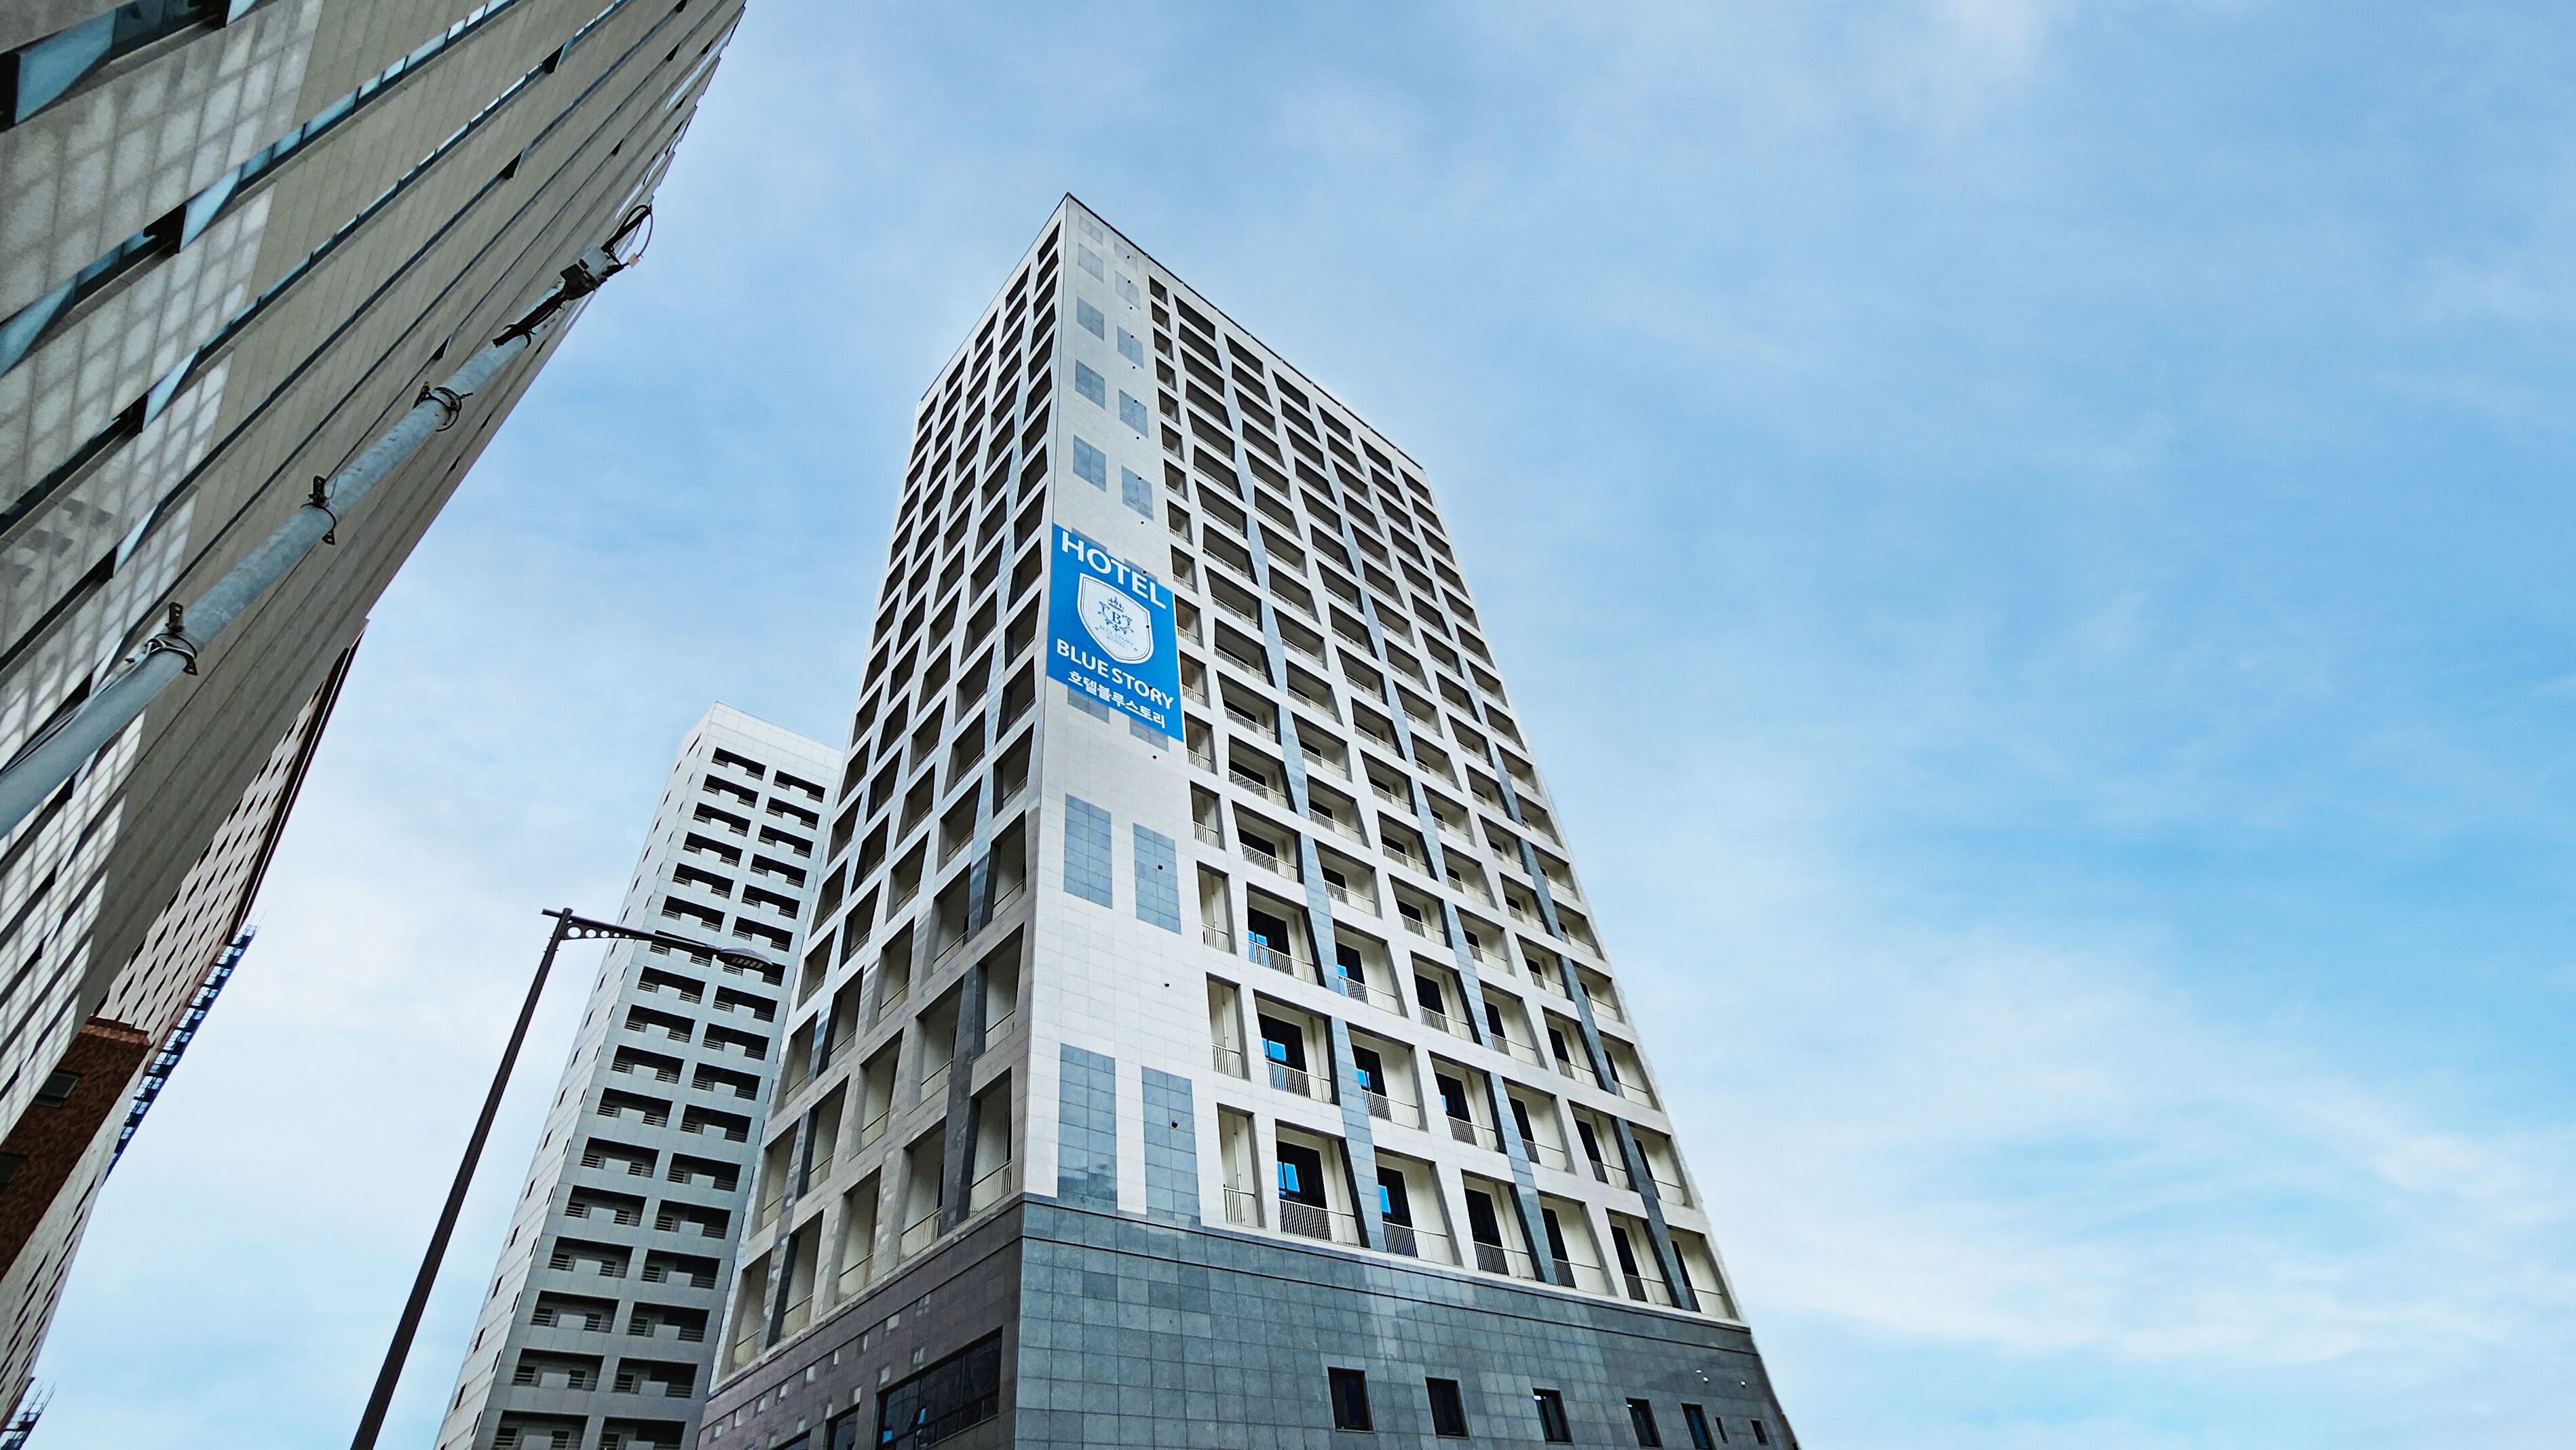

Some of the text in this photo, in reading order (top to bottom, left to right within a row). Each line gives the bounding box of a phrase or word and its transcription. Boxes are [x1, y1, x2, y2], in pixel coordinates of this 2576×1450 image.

[1061, 530, 1167, 609] HOTEL
[1057, 638, 1174, 710] BLUE STORY
[1068, 670, 1166, 729] 호텔블루스토리
